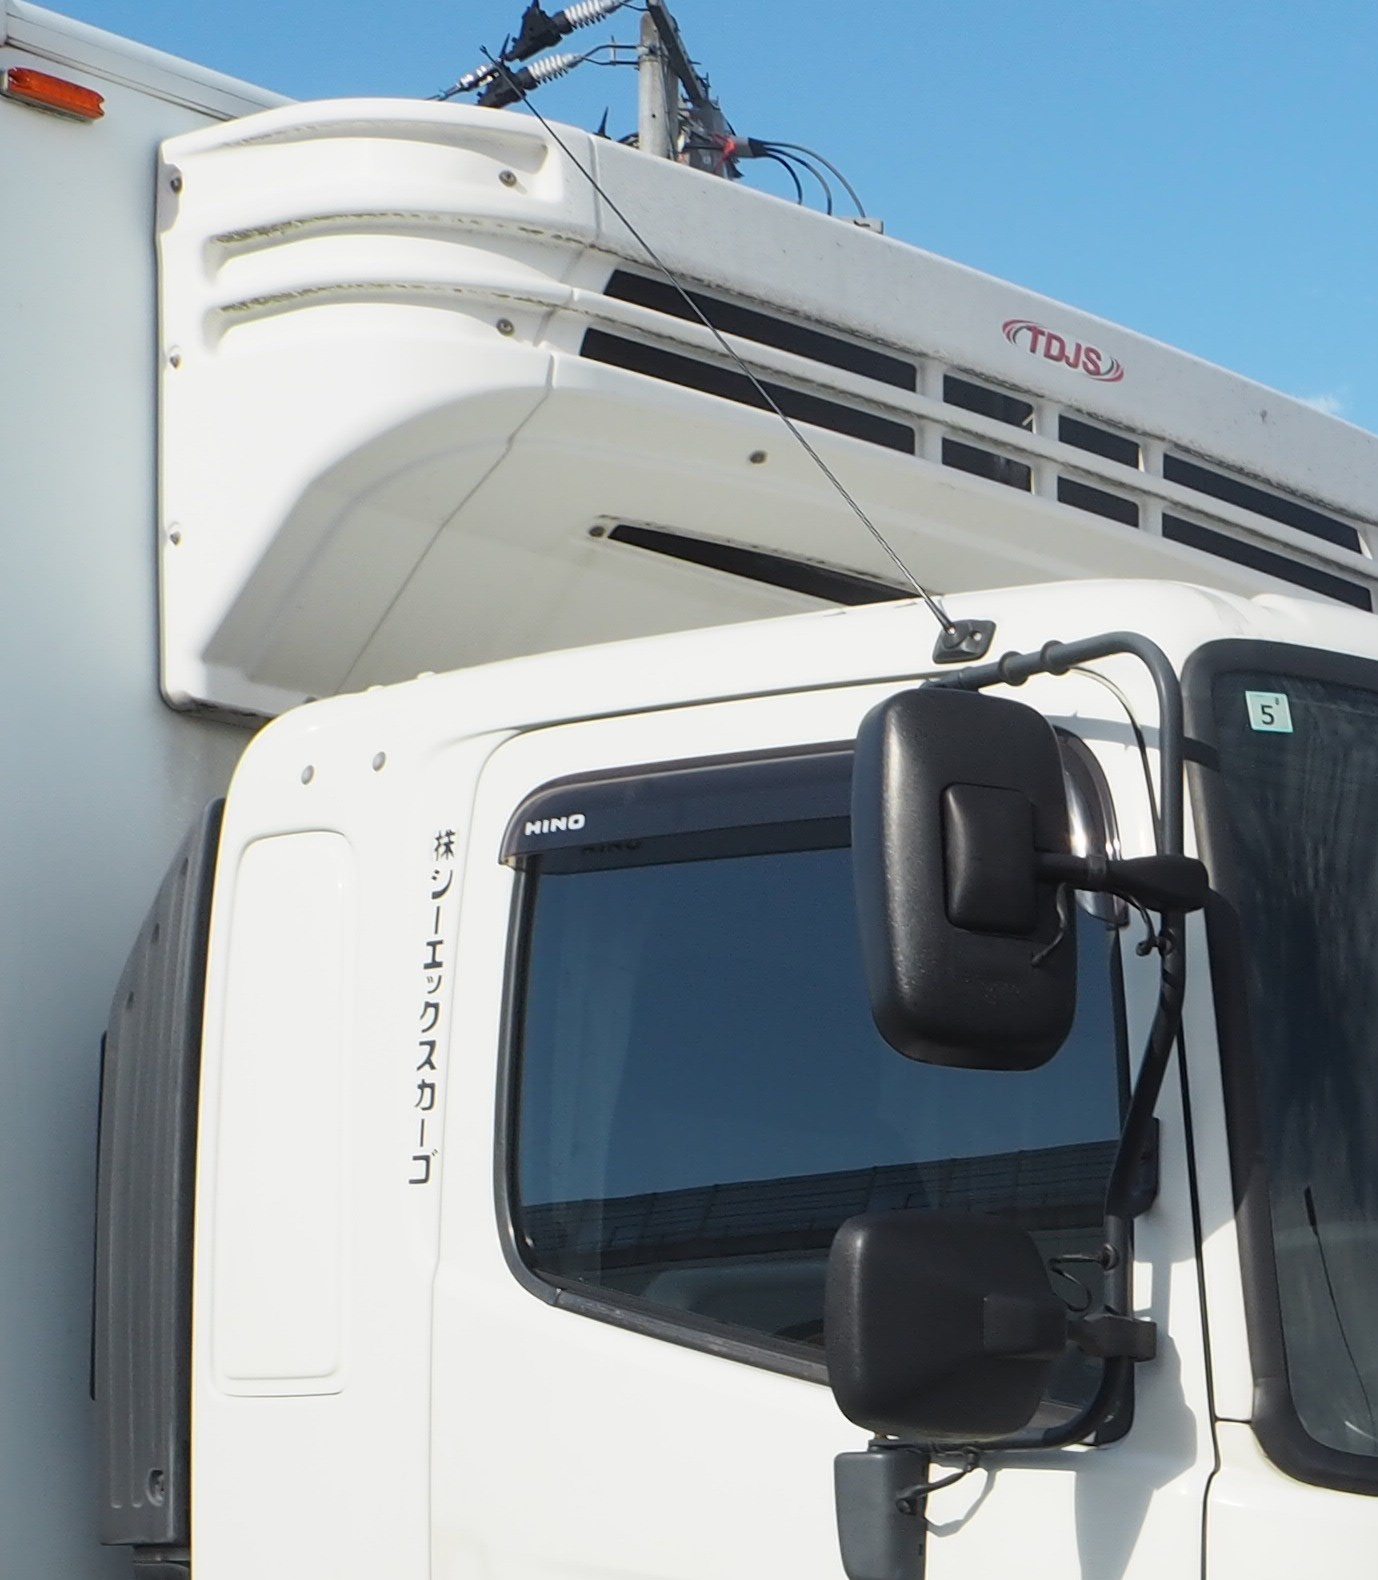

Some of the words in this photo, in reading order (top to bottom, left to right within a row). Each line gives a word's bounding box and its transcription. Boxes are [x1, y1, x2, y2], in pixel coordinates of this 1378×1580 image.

[1026, 325, 1102, 376] TDJS
[1261, 703, 1275, 725] 5
[525, 813, 586, 836] HINO
